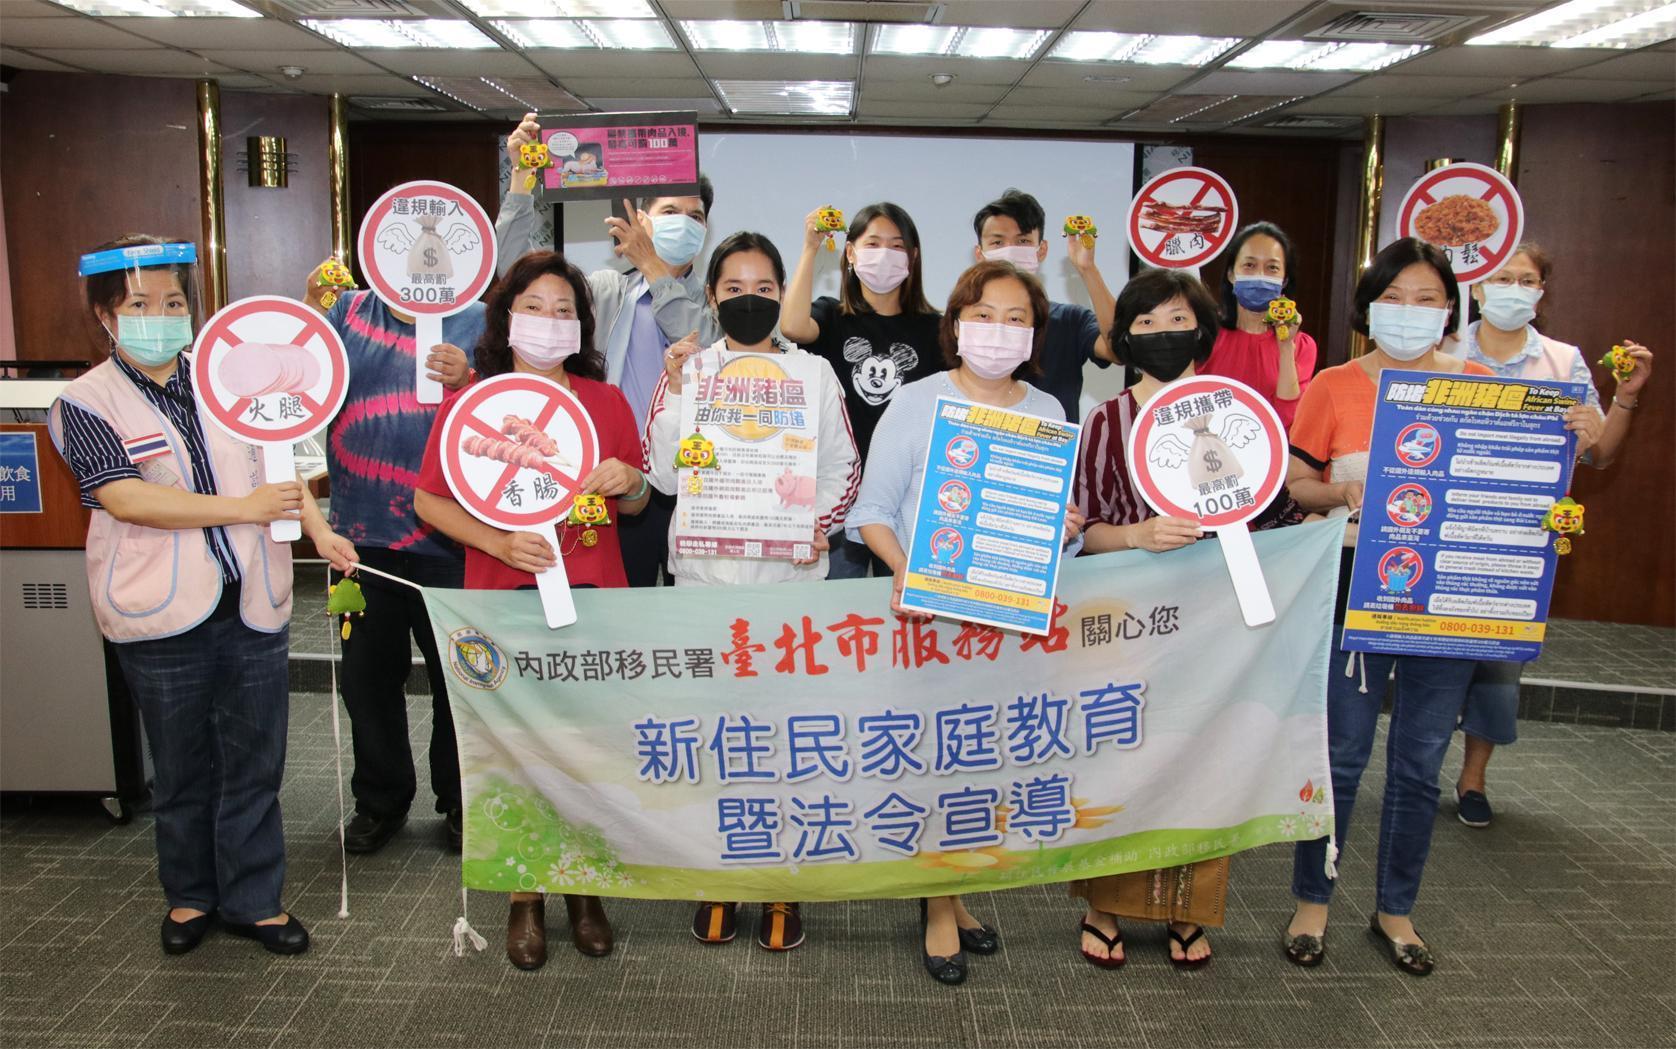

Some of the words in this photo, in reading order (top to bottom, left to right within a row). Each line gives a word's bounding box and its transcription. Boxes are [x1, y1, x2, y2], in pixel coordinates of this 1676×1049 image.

[392, 197, 465, 217] 違規輸入
[411, 273, 448, 286] 最高罰
[400, 286, 456, 304] 300萬
[694, 374, 808, 407] 非洲豬瘟
[1525, 396, 1553, 405] African
[1529, 387, 1540, 396] To
[1541, 388, 1560, 398] Keep
[248, 396, 306, 424] 火腿
[694, 408, 806, 427] 由你我一同防堵
[1153, 389, 1233, 427] 違規攜帶
[1523, 403, 1544, 412] Fever
[0, 485, 16, 502] 用
[502, 473, 559, 508] 香腸
[1198, 474, 1239, 497] 最高罰
[1193, 486, 1256, 518] 100萬
[1439, 620, 1515, 636] 0800-039-131
[513, 647, 716, 683] 內政部移民署
[1081, 604, 1181, 649] 關心您
[632, 681, 1144, 783] 新住民家庭教育
[716, 772, 1076, 861] 暨法令宣導
